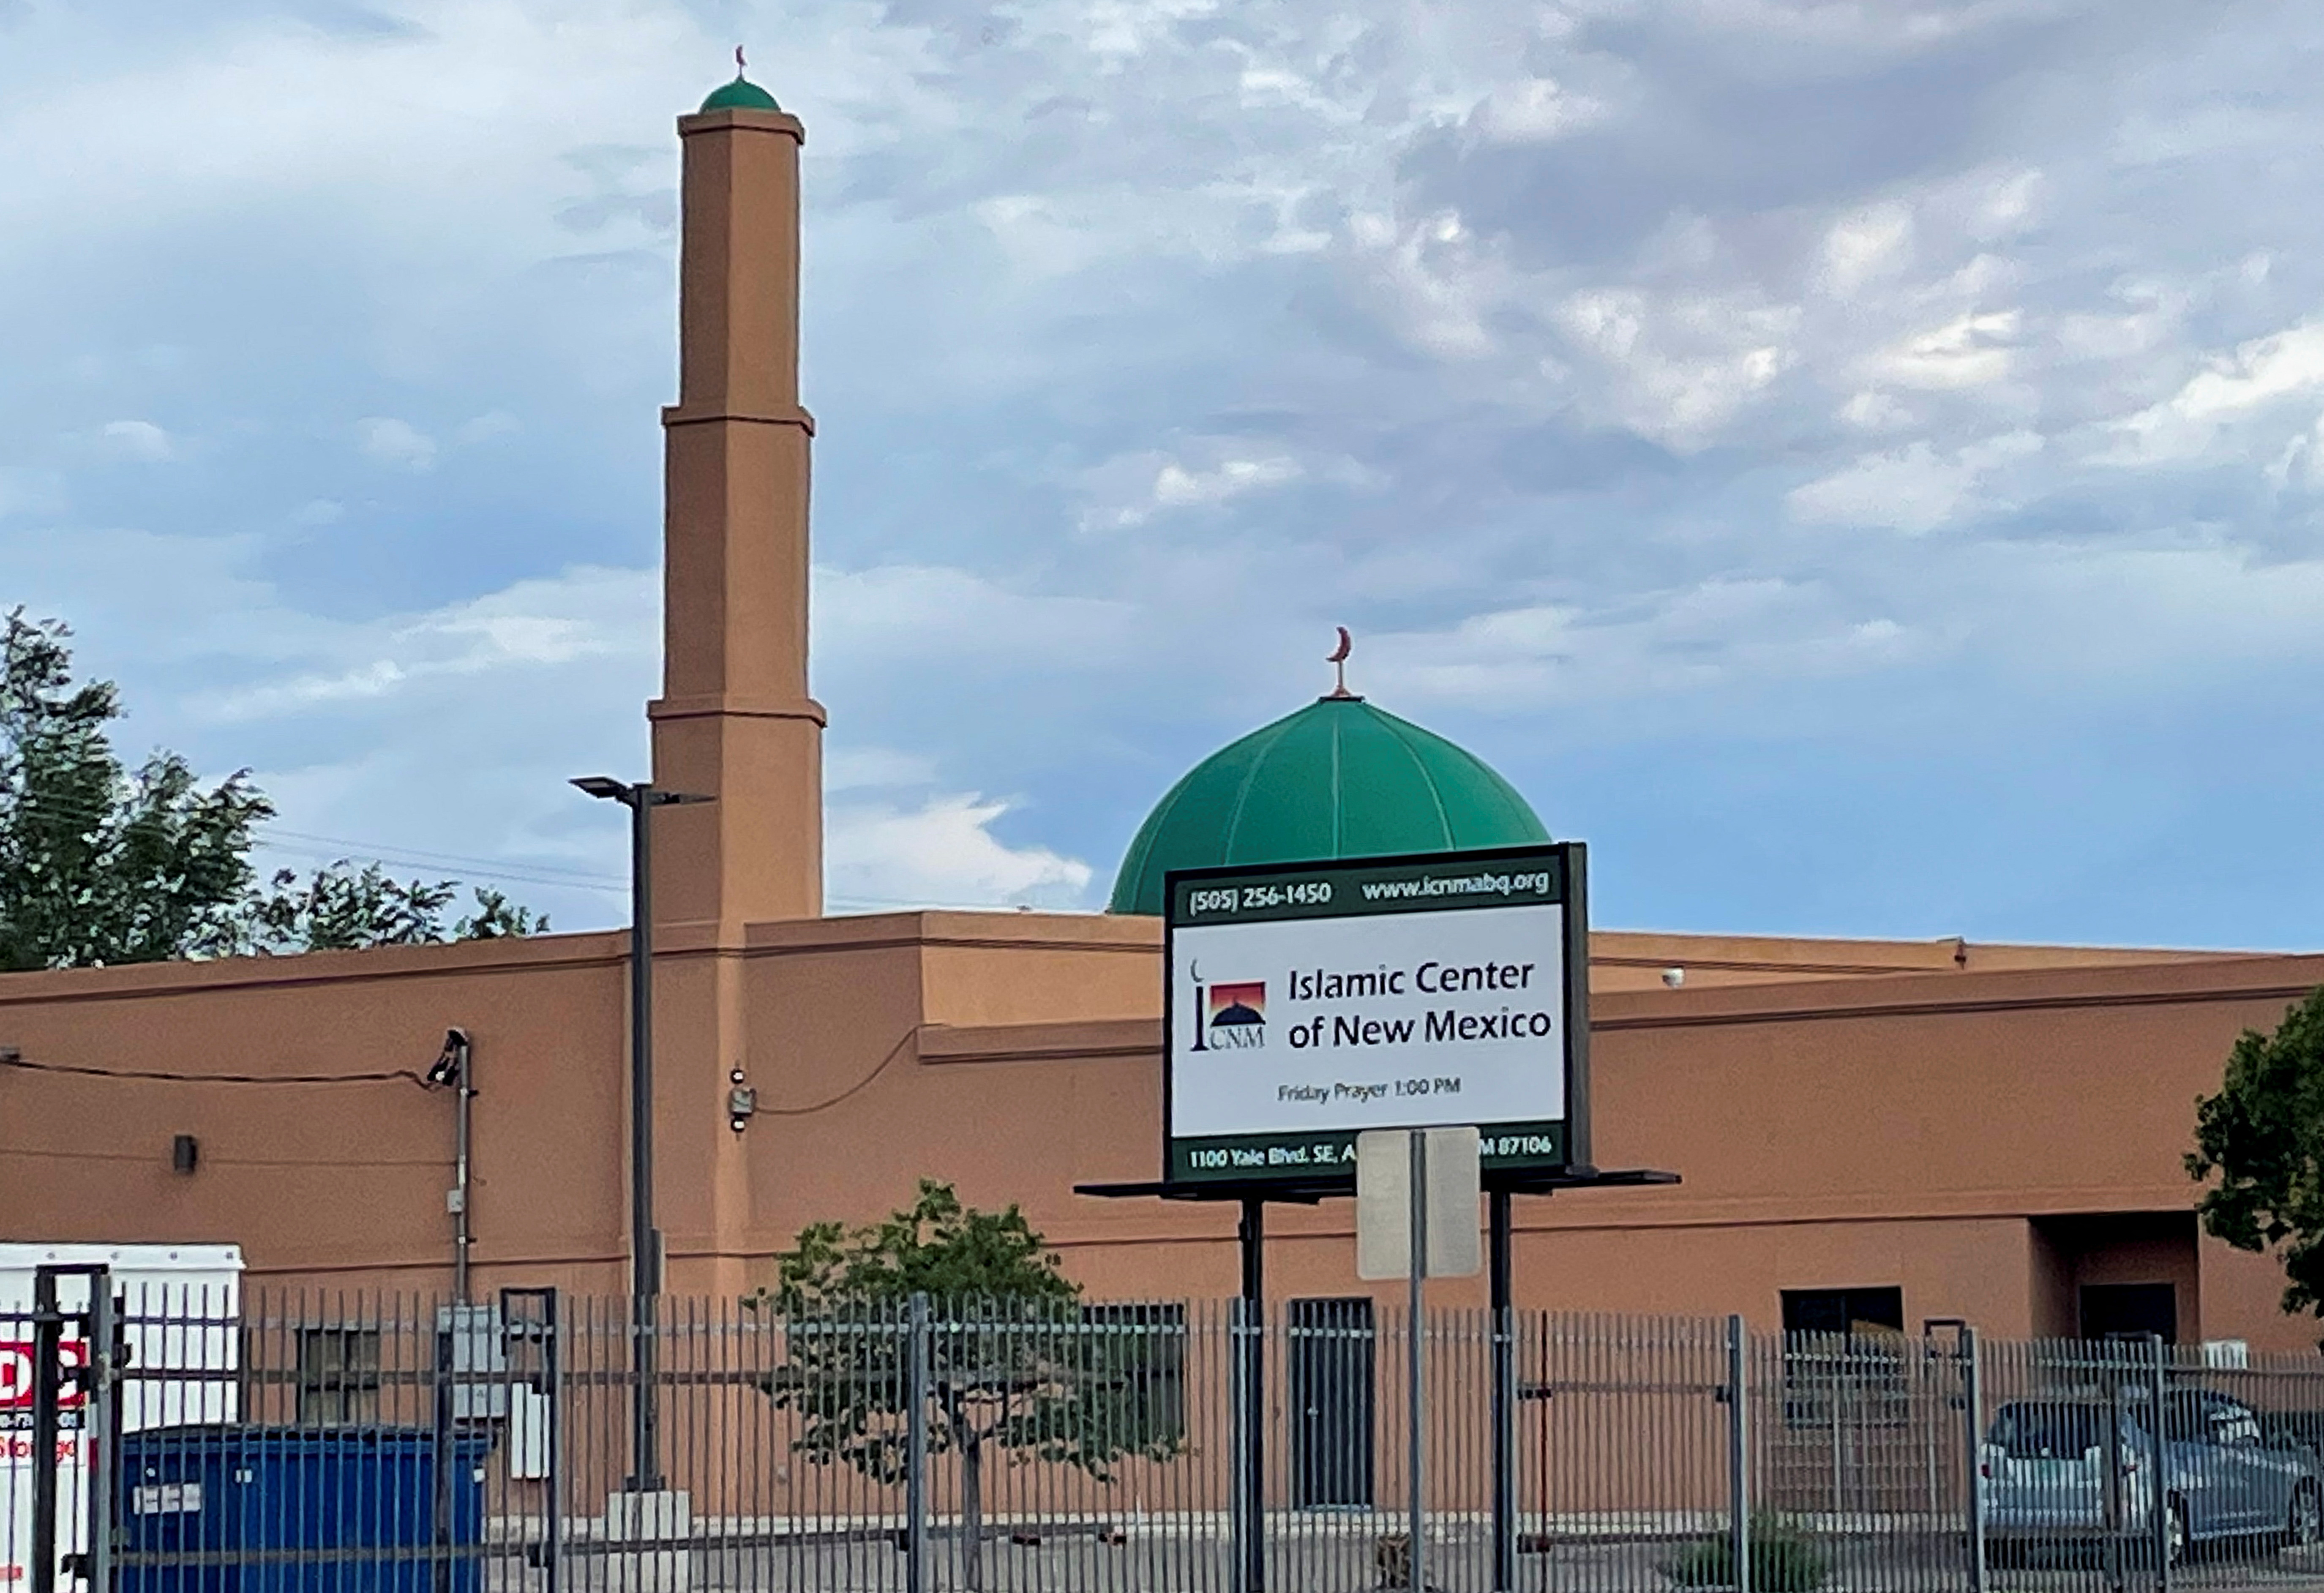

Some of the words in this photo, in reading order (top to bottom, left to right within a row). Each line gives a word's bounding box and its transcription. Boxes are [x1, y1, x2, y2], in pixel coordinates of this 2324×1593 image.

[1243, 882, 1332, 908] 256-1450
[1362, 872, 1549, 900] www.icnmabq.org
[1289, 964, 1405, 1000] Islamic
[1416, 962, 1535, 993] Center
[1289, 1015, 1325, 1048] of
[1333, 1015, 1416, 1047] New
[1425, 1007, 1551, 1042] Mexico
[1277, 1084, 1329, 1105] Friday
[1334, 1083, 1388, 1103] Prayer
[1395, 1079, 1429, 1096] 1:00
[1433, 1077, 1461, 1094] PM
[1191, 1149, 1228, 1168] 1100
[1229, 1148, 1265, 1166] Yale
[1268, 1146, 1309, 1165] Blvd.
[1498, 1135, 1552, 1155] 87106
